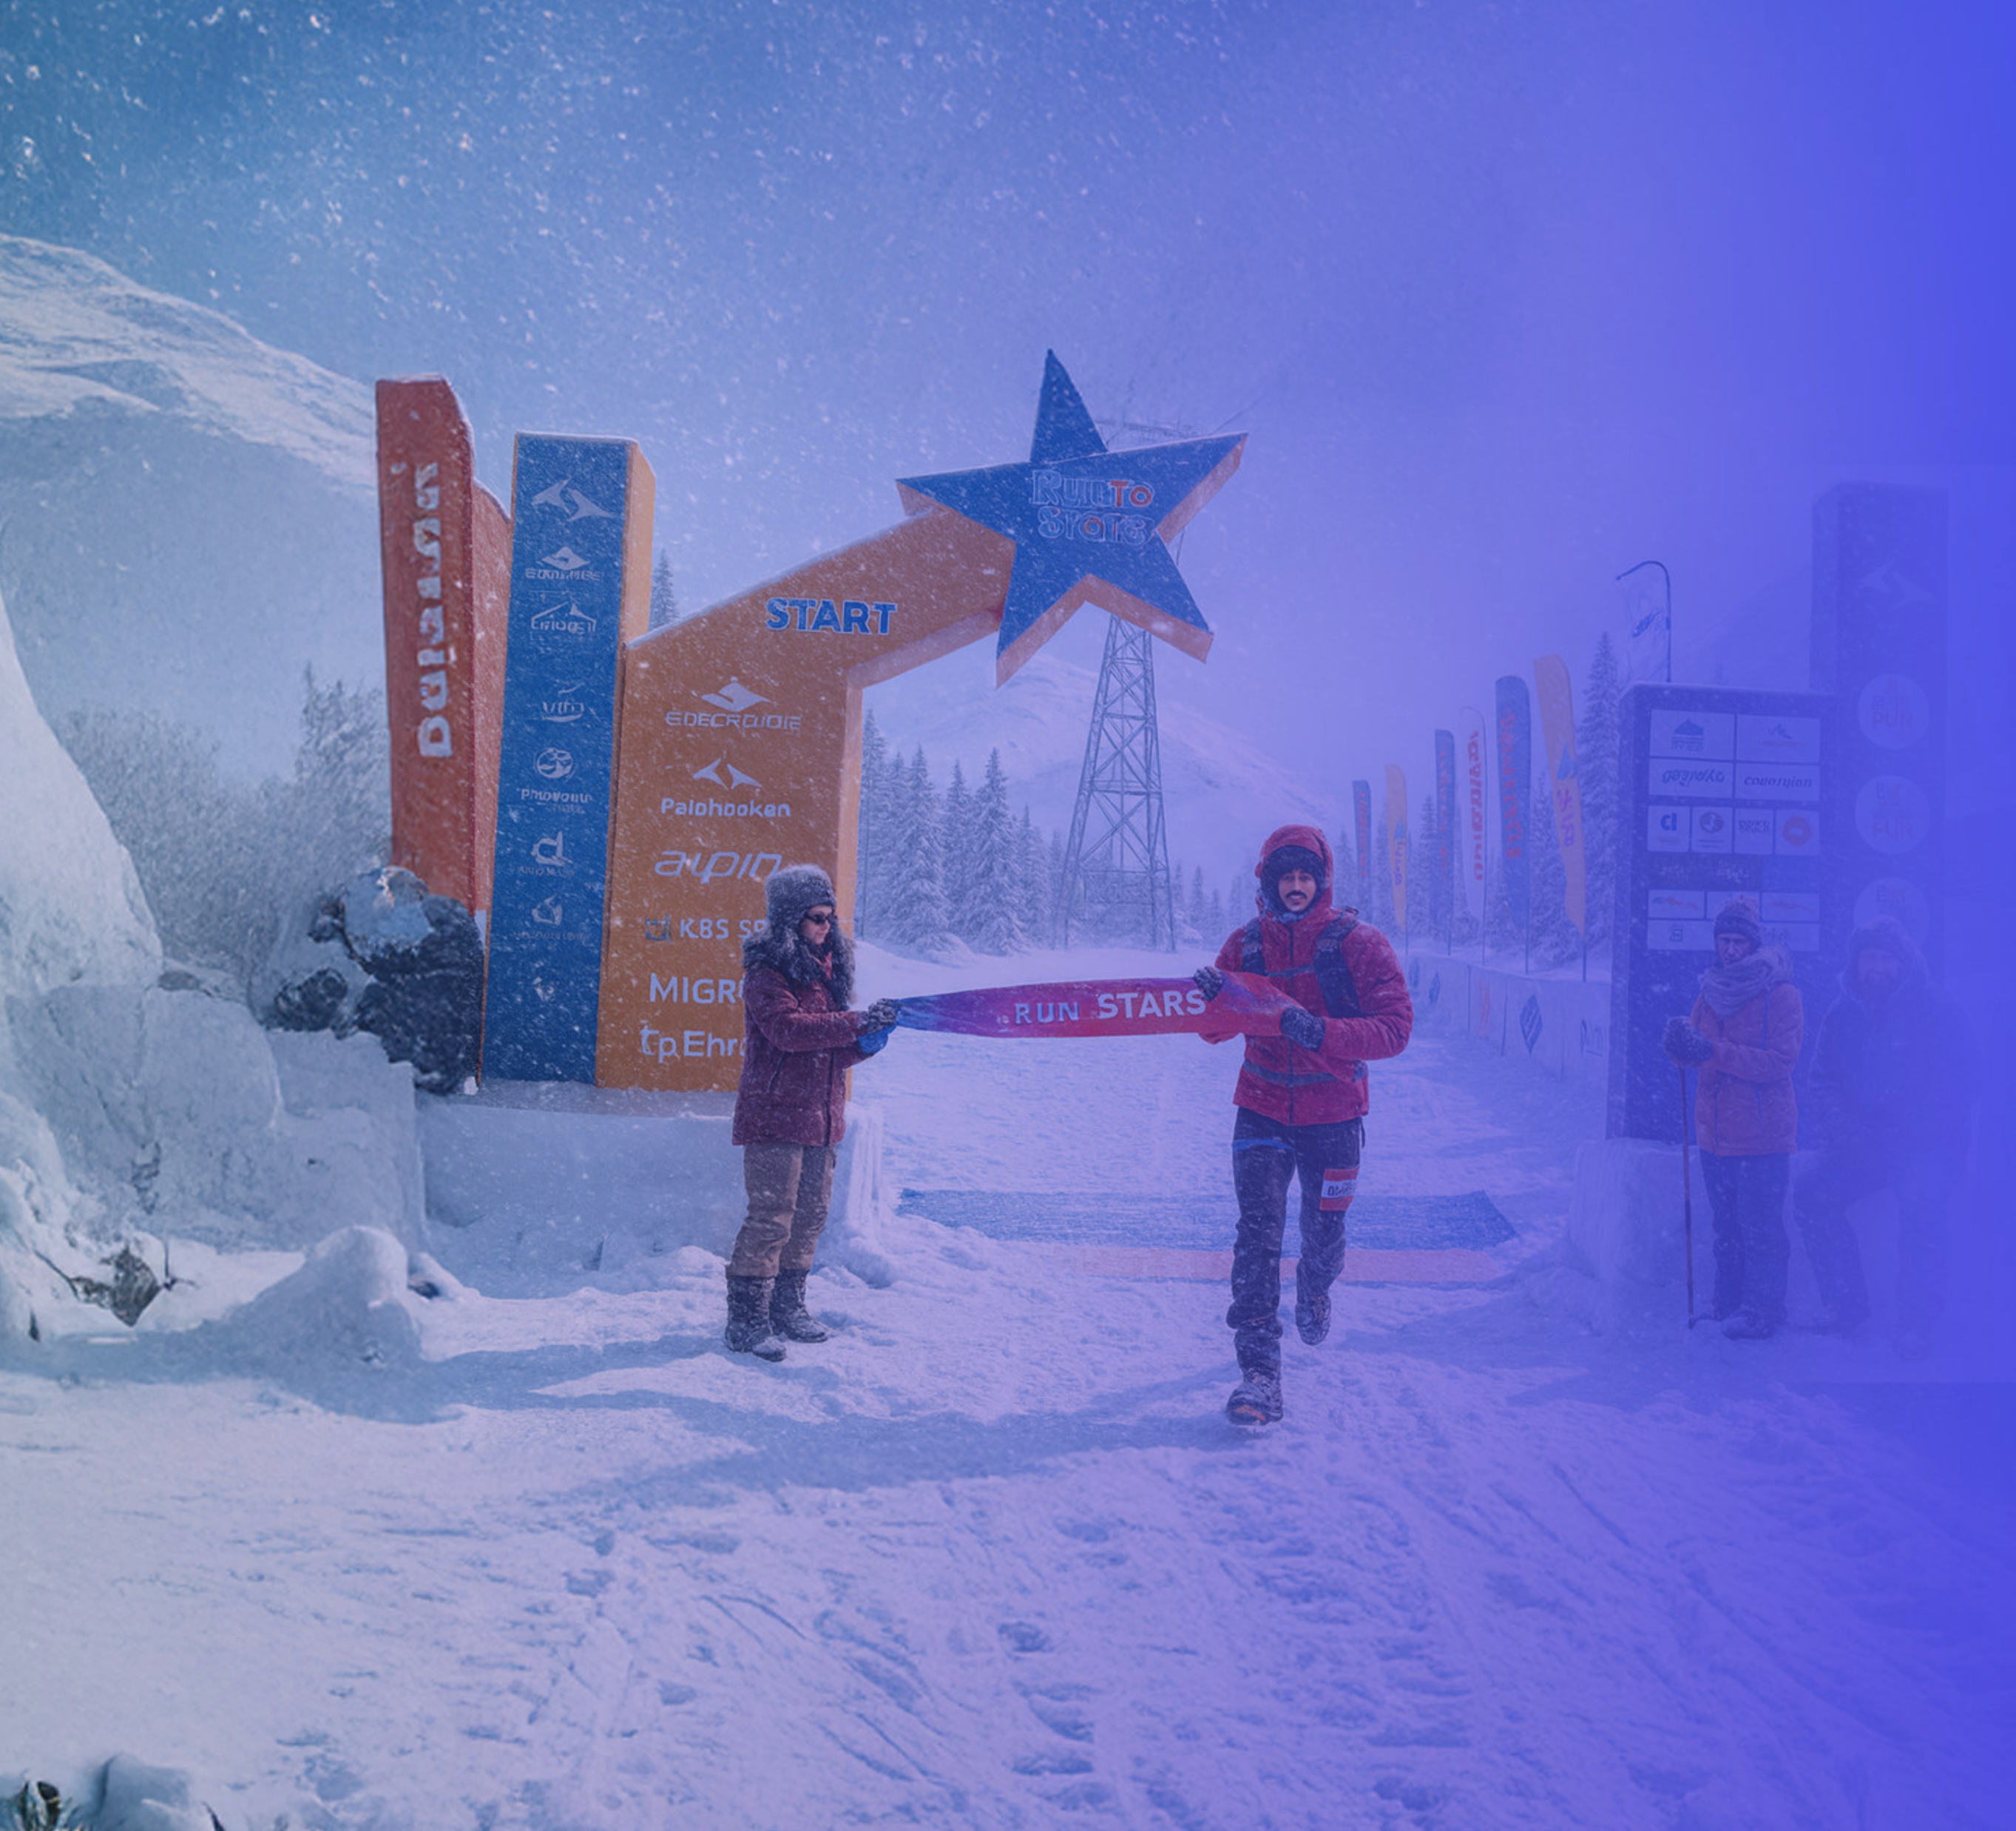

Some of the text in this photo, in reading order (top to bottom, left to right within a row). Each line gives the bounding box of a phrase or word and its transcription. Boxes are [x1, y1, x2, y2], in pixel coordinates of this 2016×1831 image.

[765, 597, 897, 635] START
[680, 918, 728, 939] KBS
[1015, 990, 1206, 1024] RUN STARS
